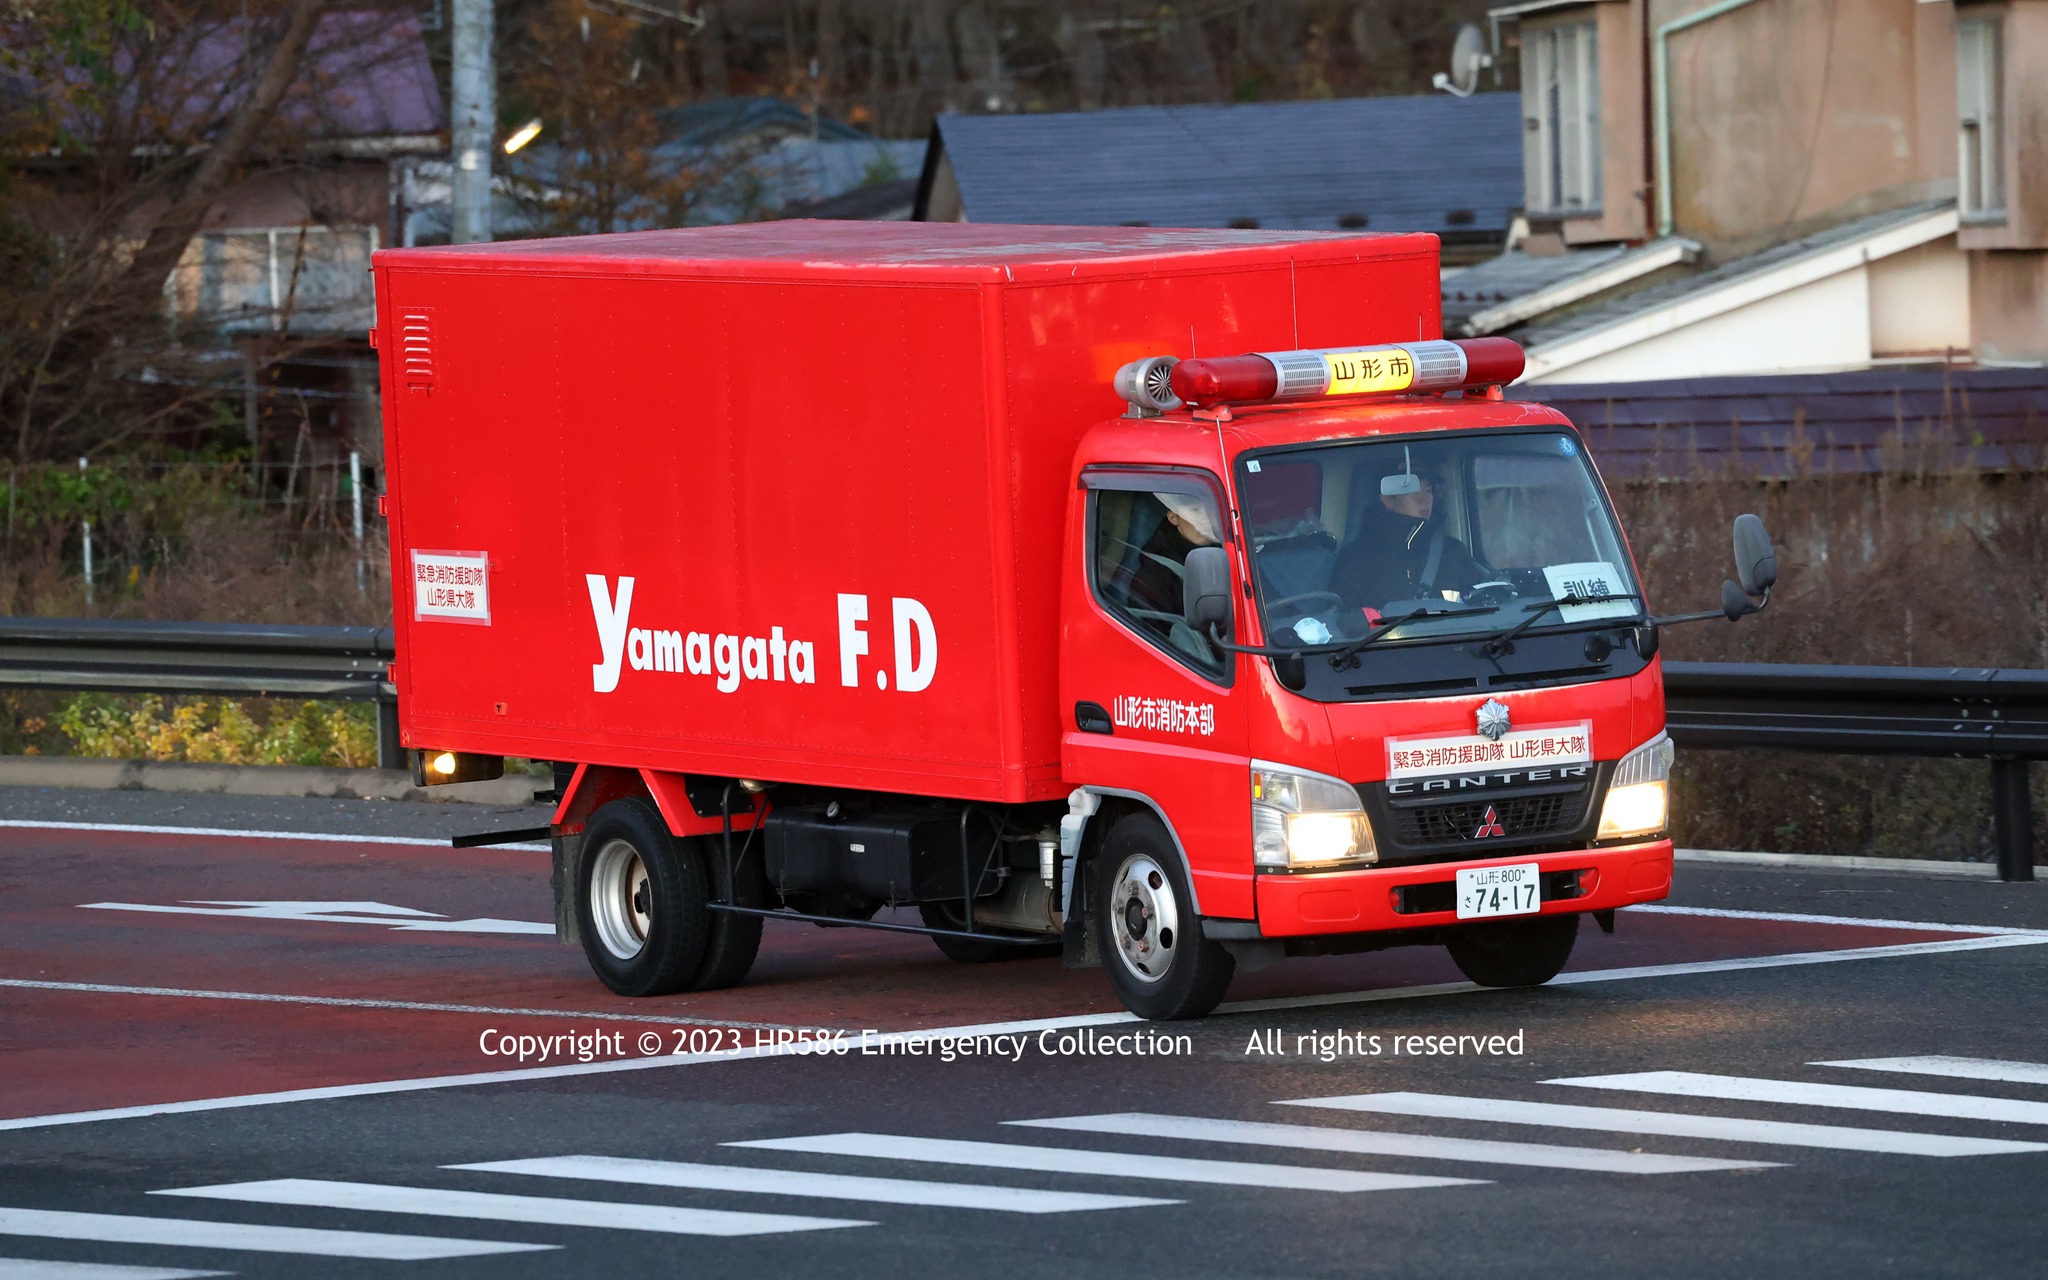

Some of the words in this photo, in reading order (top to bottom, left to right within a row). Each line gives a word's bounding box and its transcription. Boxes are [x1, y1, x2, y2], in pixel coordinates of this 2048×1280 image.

[1334, 357, 1409, 380] 山形市
[417, 564, 484, 586] 緊急消防援助隊
[427, 588, 475, 609] 山形県大隊
[1563, 578, 1611, 606] 訓練
[837, 593, 938, 692] F.D
[1114, 694, 1215, 736] 山形市消防本部
[1393, 743, 1505, 770] 緊急消防援助隊
[1509, 735, 1586, 760] 山形県大隊
[1389, 766, 1587, 794] CANTER
[1477, 871, 1499, 885] 山形
[1501, 869, 1521, 883] 800
[1465, 896, 1471, 908] さ
[1476, 884, 1535, 913] 74-17
